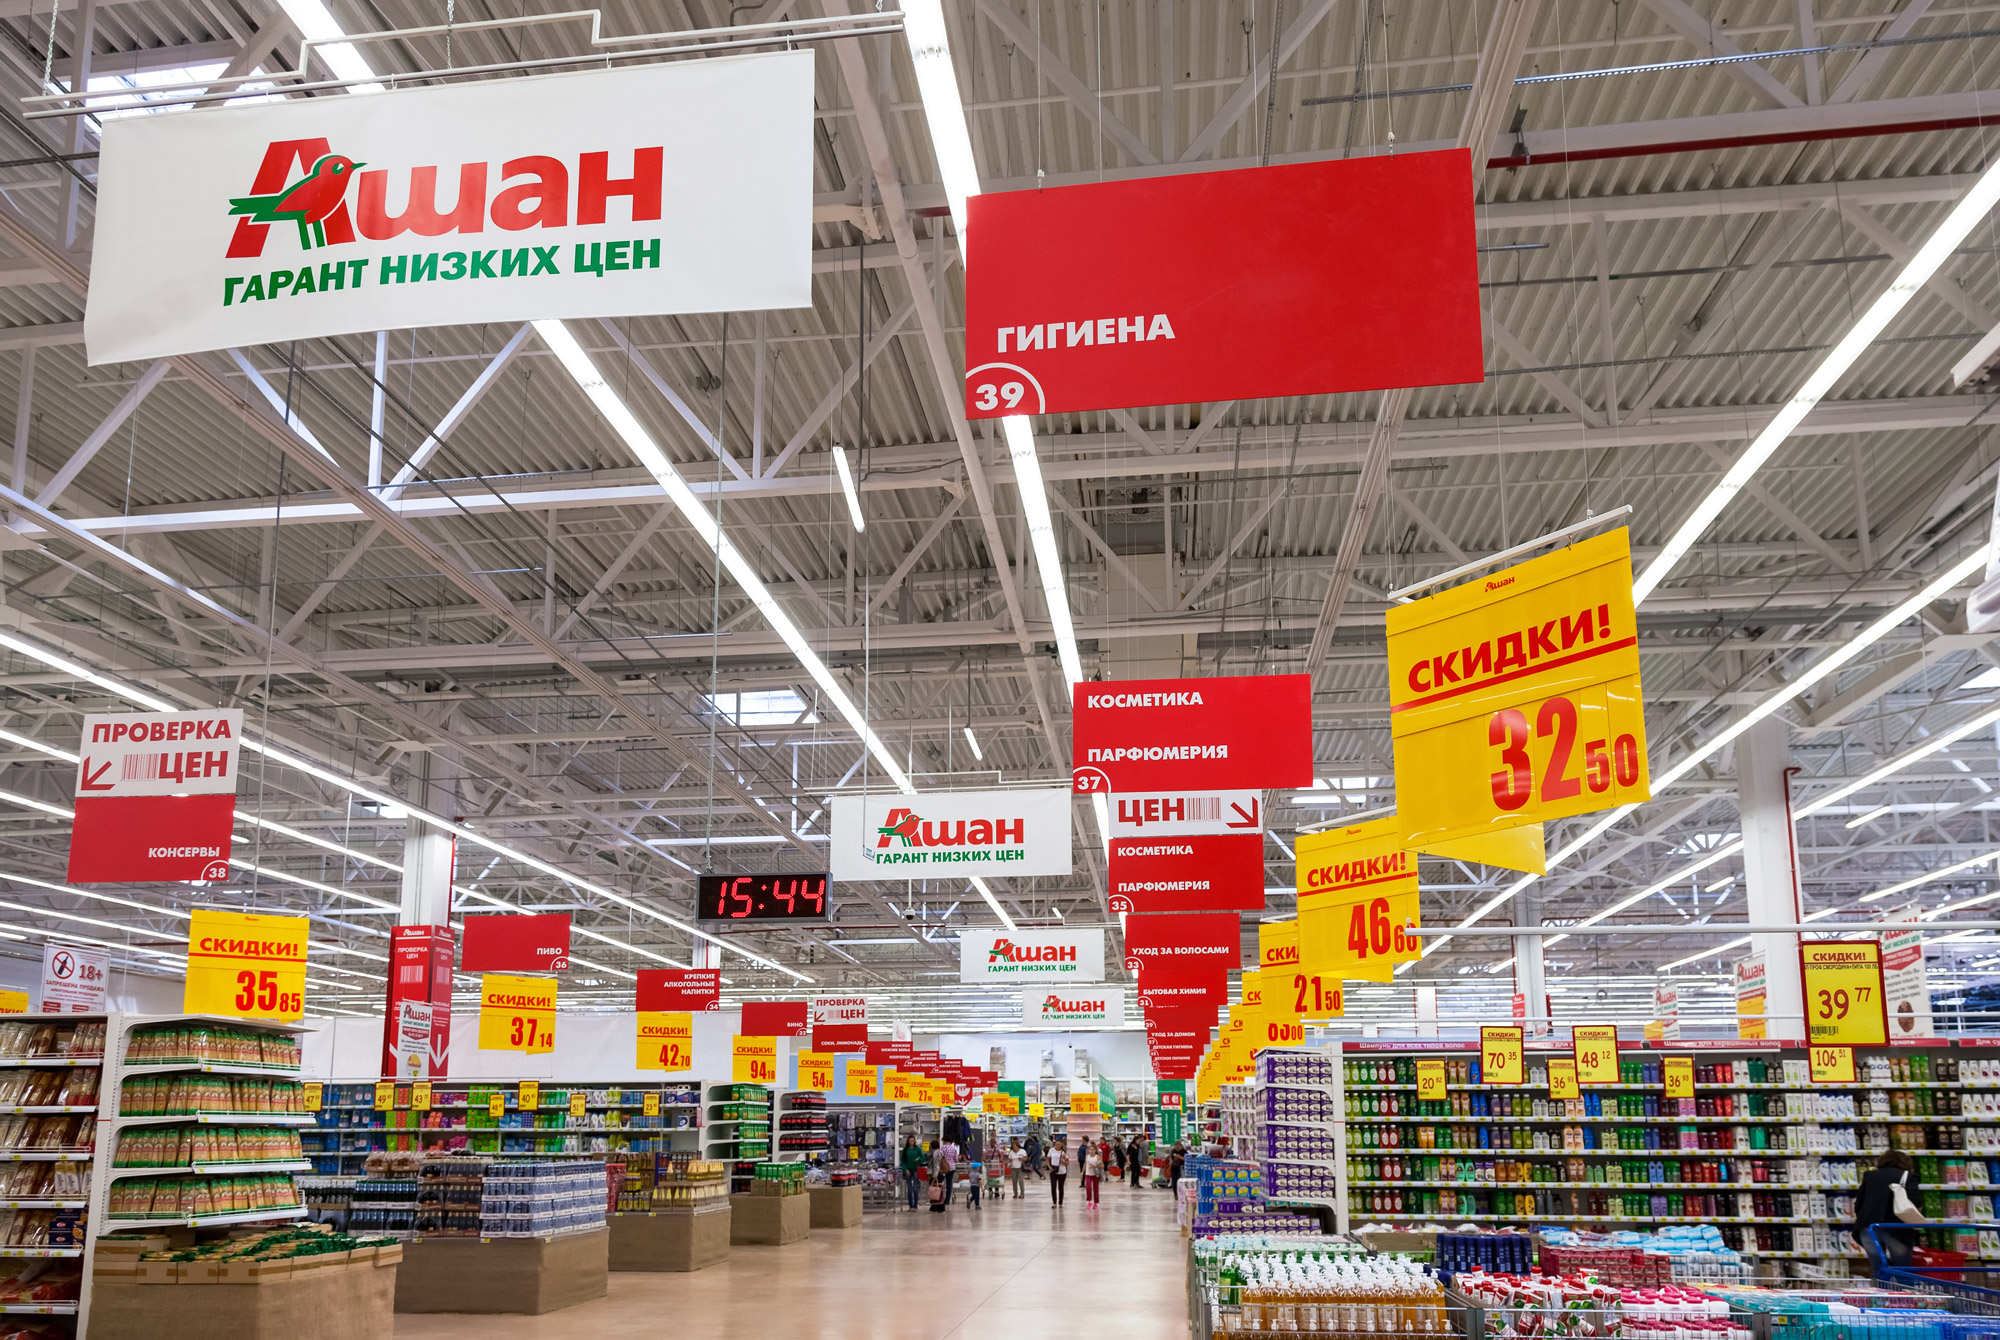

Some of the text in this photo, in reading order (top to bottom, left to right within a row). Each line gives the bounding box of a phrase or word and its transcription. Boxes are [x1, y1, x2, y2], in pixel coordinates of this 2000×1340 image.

[226, 137, 663, 258] Ашан
[224, 238, 661, 306] ГАРАНТ НИЗКИХ ЦЕН
[997, 314, 1176, 353] ГИГИЕНА
[975, 382, 1025, 411] 39
[1485, 576, 1515, 593] Ашан
[1408, 603, 1611, 693] СКИДКИ!
[1088, 692, 1203, 708] КОСМЕТИКА
[92, 720, 231, 743] ПРОВЕРКА
[1088, 745, 1228, 762] ПАРФЮМЕРИЯ
[158, 751, 229, 783] ЦЕН
[1078, 776, 1101, 790] 37
[1118, 798, 1185, 826] ЦЕН
[877, 808, 1024, 848] Ашан
[148, 846, 220, 858] КОНСЕРВЫ
[876, 849, 1024, 864] ГАРАНТ НИЗКИХ ЦЕН
[1117, 845, 1194, 856] КОСМЕТИКА
[209, 867, 226, 878] 38
[1307, 852, 1406, 887] СКИДКИ!
[1118, 881, 1210, 892] ПАРФЮМЕРИЯ
[718, 876, 826, 918] 15:44
[1111, 901, 1127, 910] 35
[200, 937, 298, 956] СКИДКИ!
[536, 947, 562, 955] ПИВО
[988, 939, 1076, 962] Ашан
[1132, 947, 1158, 955] УХОД
[1175, 947, 1229, 955] ВОЛОСАМИ
[555, 961, 567, 969] 36
[1127, 961, 1139, 969] 33
[1813, 952, 1866, 962] СКИДКИ!
[79, 965, 103, 981] 18+
[1737, 963, 1765, 983] Ашан
[488, 994, 551, 1007] СКИДКИ!
[816, 998, 865, 1006] ПРОВЕРКА
[1042, 995, 1105, 1012] Ашан
[1819, 987, 1871, 1020] 39 77
[404, 1005, 430, 1022] Ашан
[840, 1009, 865, 1020] ЦЕН
[642, 1025, 688, 1036] СКИДКИ!
[736, 1046, 773, 1054] СКИДКИ!
[1816, 1049, 1837, 1067] 106
[801, 1059, 831, 1067] СКИДКИ!
[1488, 1052, 1517, 1069] 70 35
[1581, 1051, 1610, 1068] 48 12
[1422, 1078, 1434, 1089] 20
[1553, 1077, 1565, 1089] 36
[1669, 1076, 1680, 1087] 36
